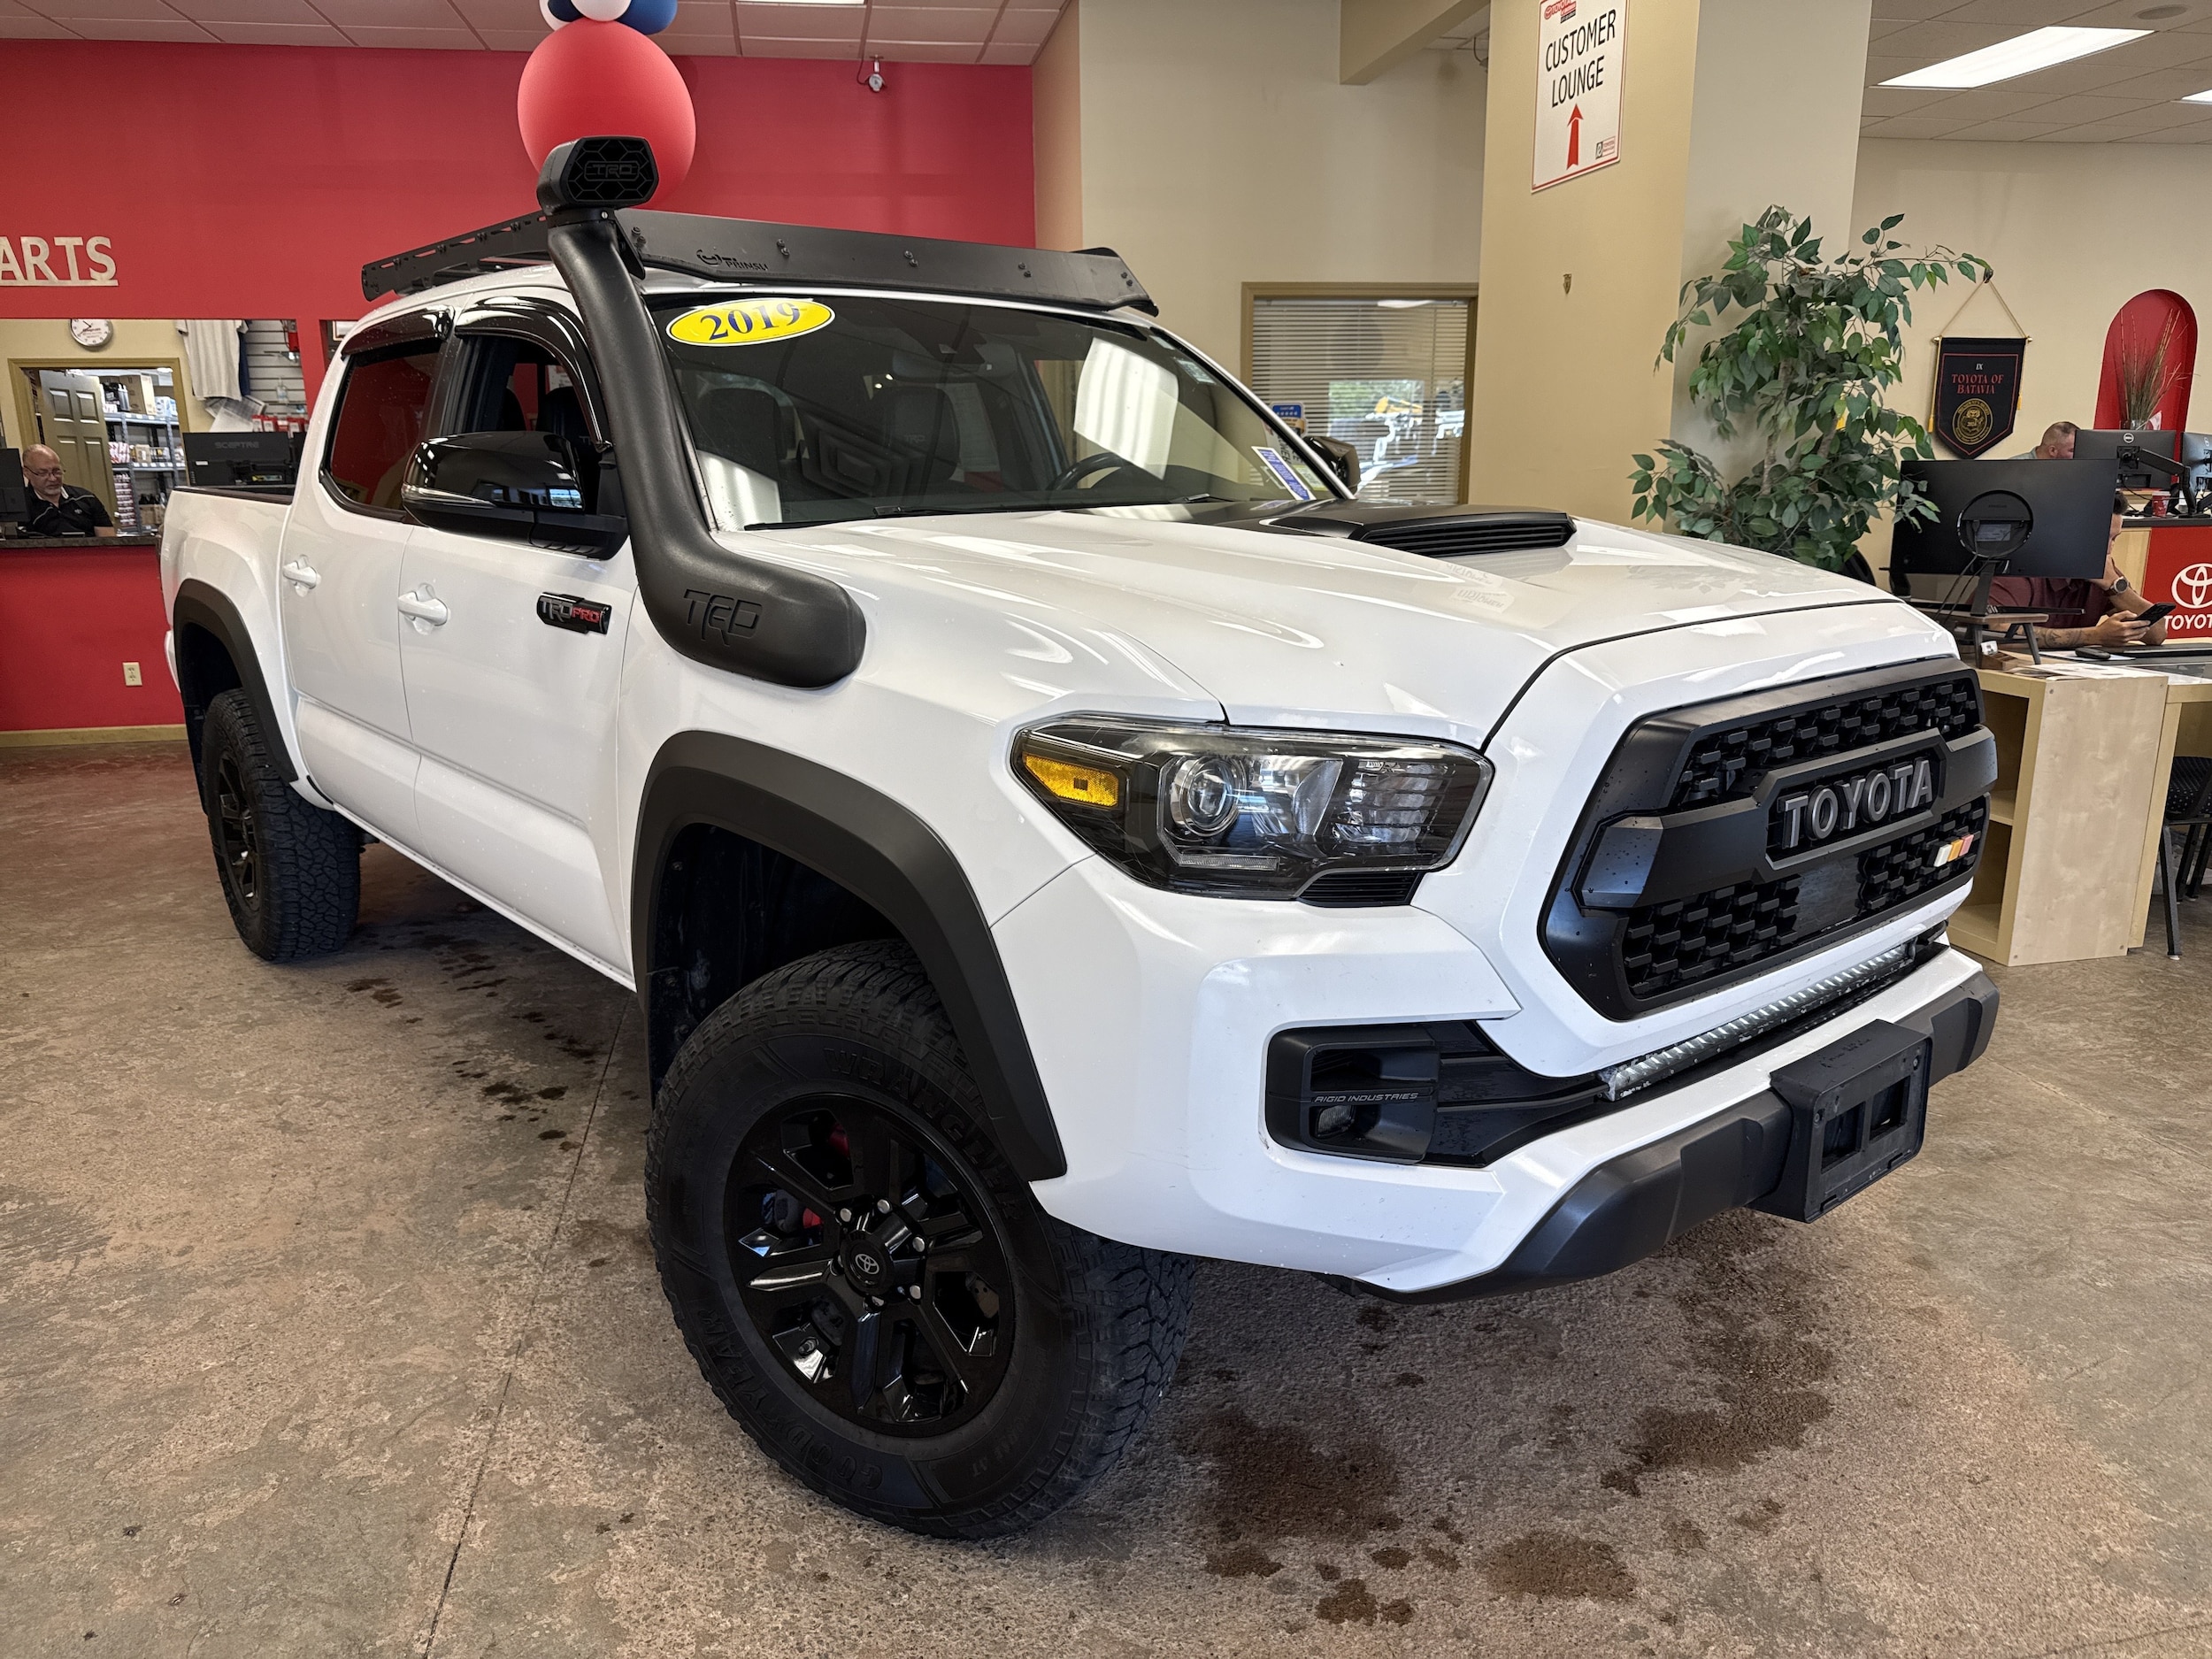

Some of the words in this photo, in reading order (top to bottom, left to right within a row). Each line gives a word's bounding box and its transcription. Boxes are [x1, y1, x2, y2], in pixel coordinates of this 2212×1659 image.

[1545, 9, 1617, 73] CUSTOMER
[1551, 55, 1605, 108] LOUNGE
[593, 164, 633, 178] TRD
[700, 302, 801, 341] 2019
[1951, 373, 1988, 384] TOYOTA
[1991, 374, 2004, 384] OF
[1956, 384, 1995, 395] BATAVIA
[541, 598, 573, 623] TRD
[572, 606, 603, 624] PRO
[683, 589, 763, 647] TRD
[1780, 758, 1933, 849] TOYOTA
[1348, 1093, 1419, 1102] INDUSTRIES
